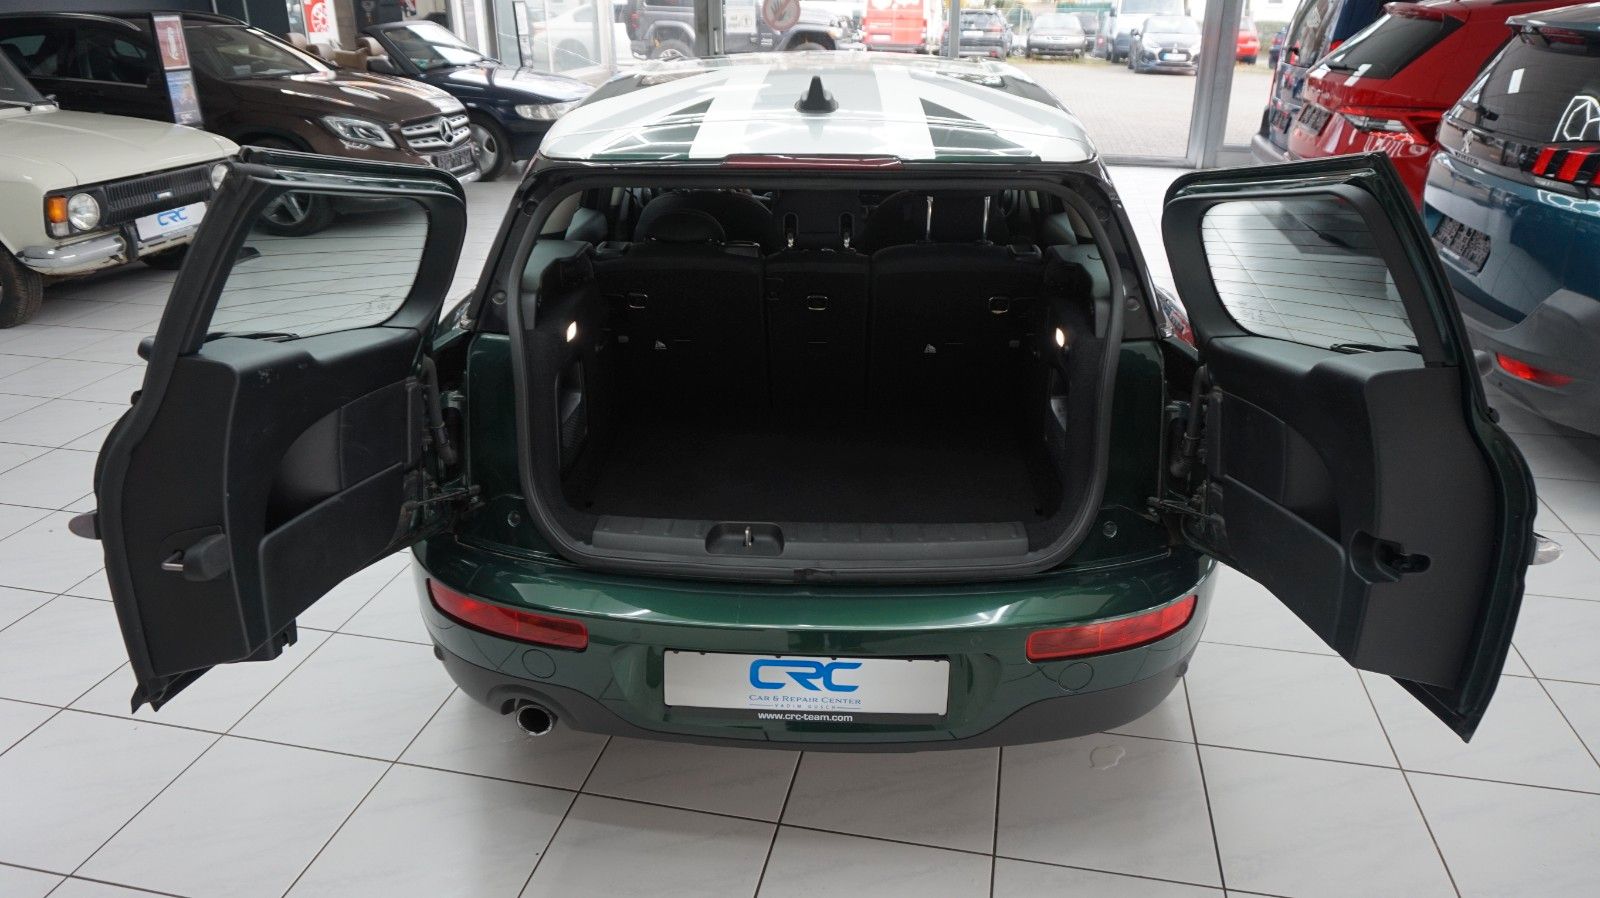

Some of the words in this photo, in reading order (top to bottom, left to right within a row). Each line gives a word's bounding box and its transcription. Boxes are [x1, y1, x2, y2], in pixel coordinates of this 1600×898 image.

[157, 207, 187, 226] CRC
[750, 659, 862, 692] CRC
[758, 712, 853, 722] www.crc-team.com
